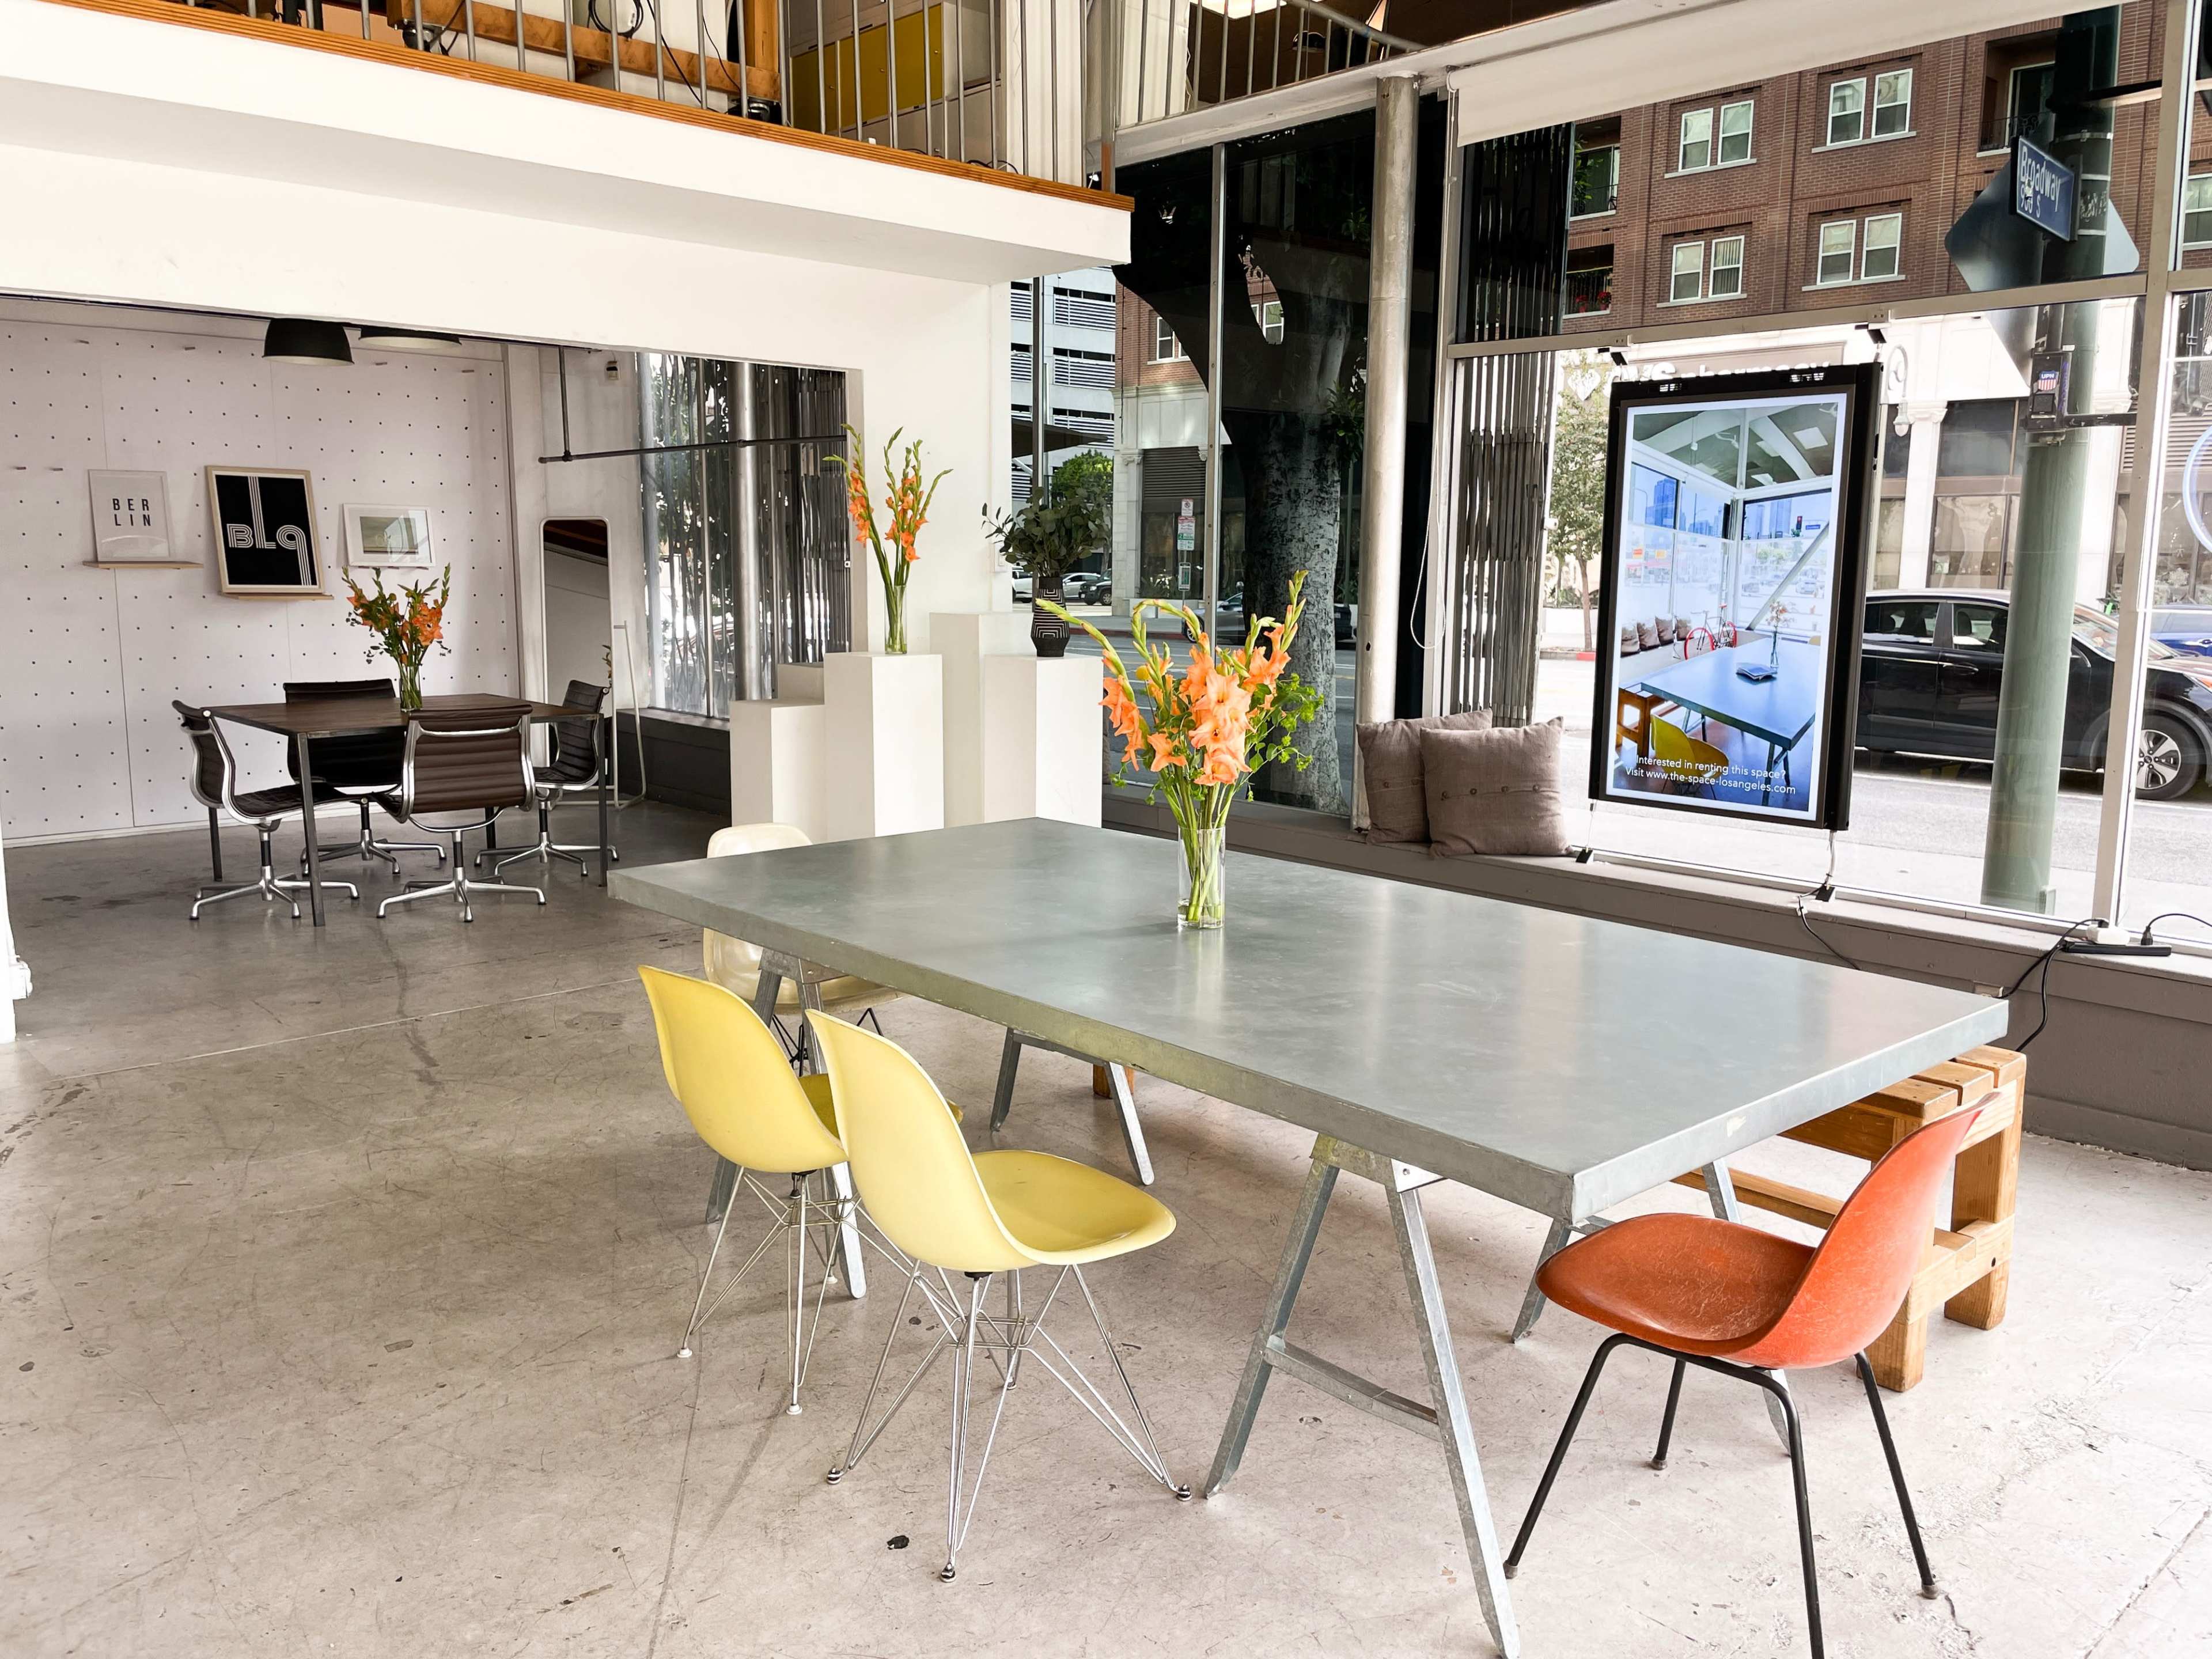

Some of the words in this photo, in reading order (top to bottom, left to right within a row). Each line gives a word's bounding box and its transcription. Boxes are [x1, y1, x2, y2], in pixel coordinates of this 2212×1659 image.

[2020, 145, 2061, 213] Broadway
[2036, 195, 2041, 218] S
[112, 498, 149, 511] BER
[114, 513, 151, 527] LIN
[1636, 755, 1682, 768] Interested
[1684, 759, 1692, 770] in
[1695, 762, 1729, 776] renting
[1731, 764, 1749, 776] this
[1751, 768, 1786, 779] space?
[1625, 767, 1644, 777] Visit
[1646, 770, 1796, 795] www.the-space-losangeles.com
